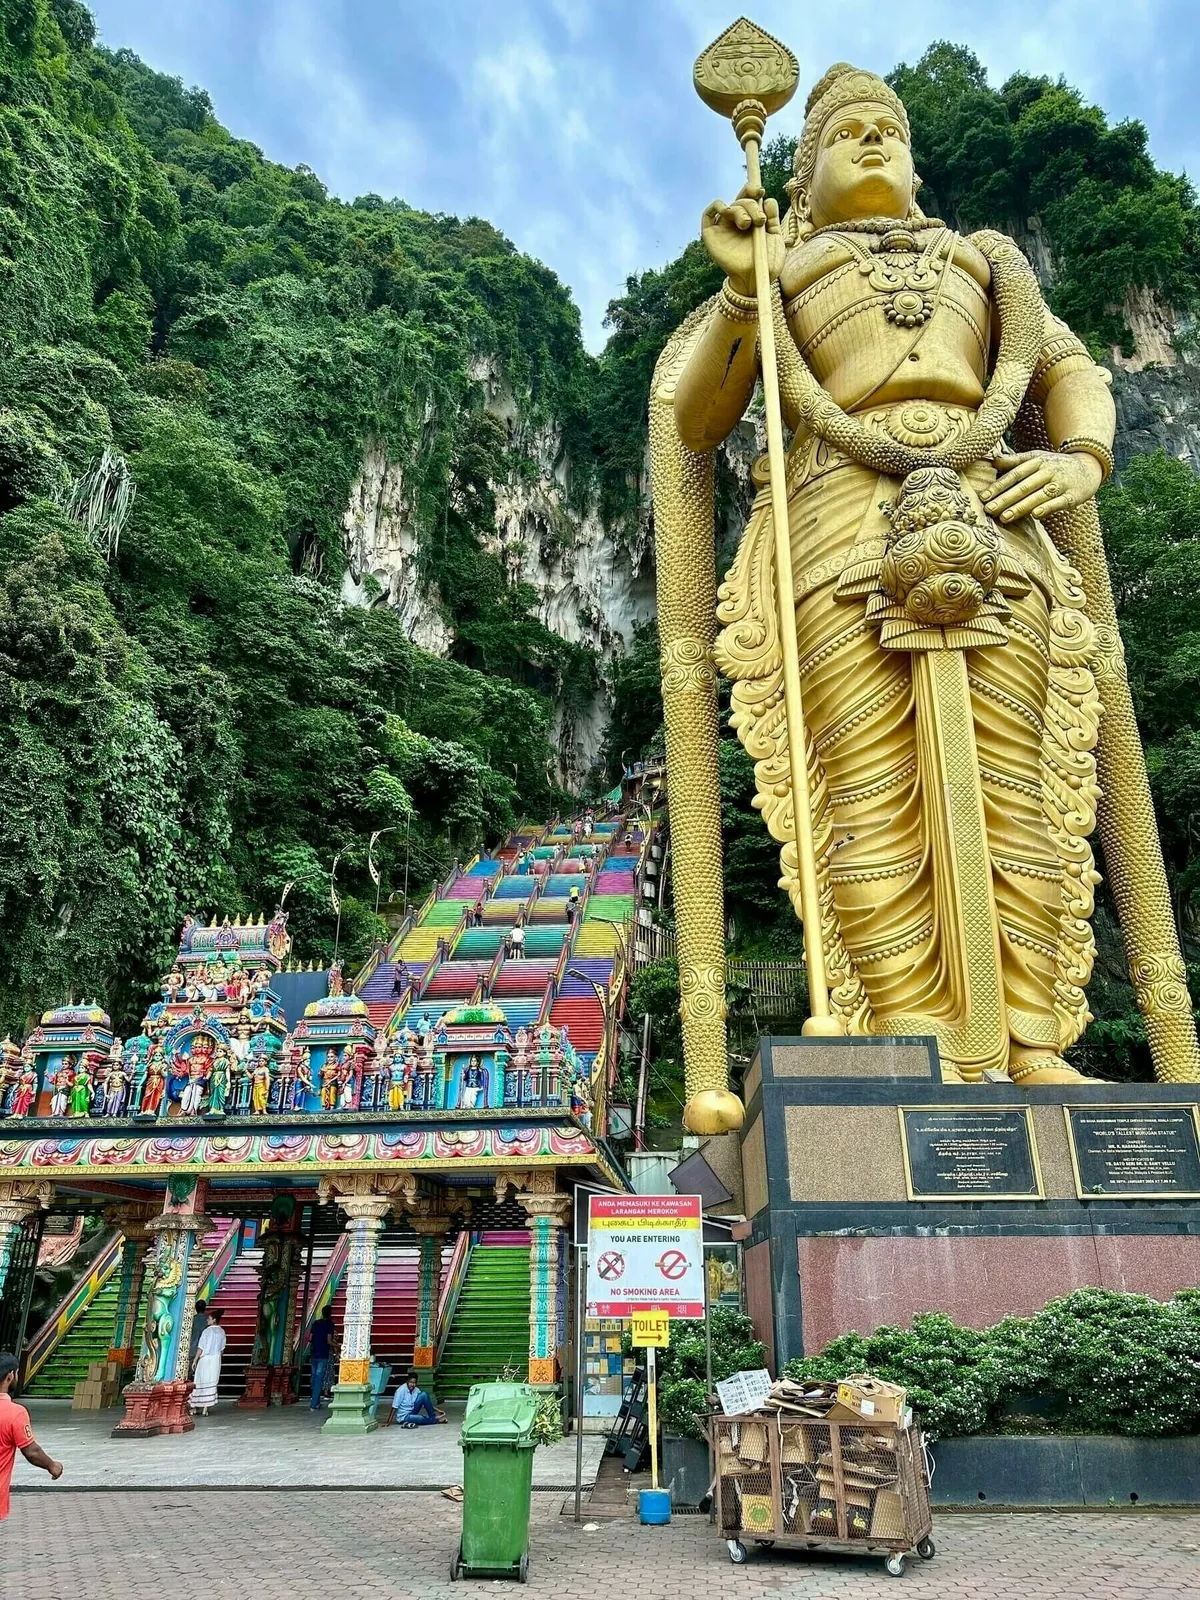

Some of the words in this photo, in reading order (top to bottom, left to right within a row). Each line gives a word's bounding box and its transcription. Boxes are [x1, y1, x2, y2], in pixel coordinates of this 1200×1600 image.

[602, 1219, 634, 1227] புகைப்
[633, 1320, 668, 1331] TOILET
[24, 1424, 32, 1438] 6
